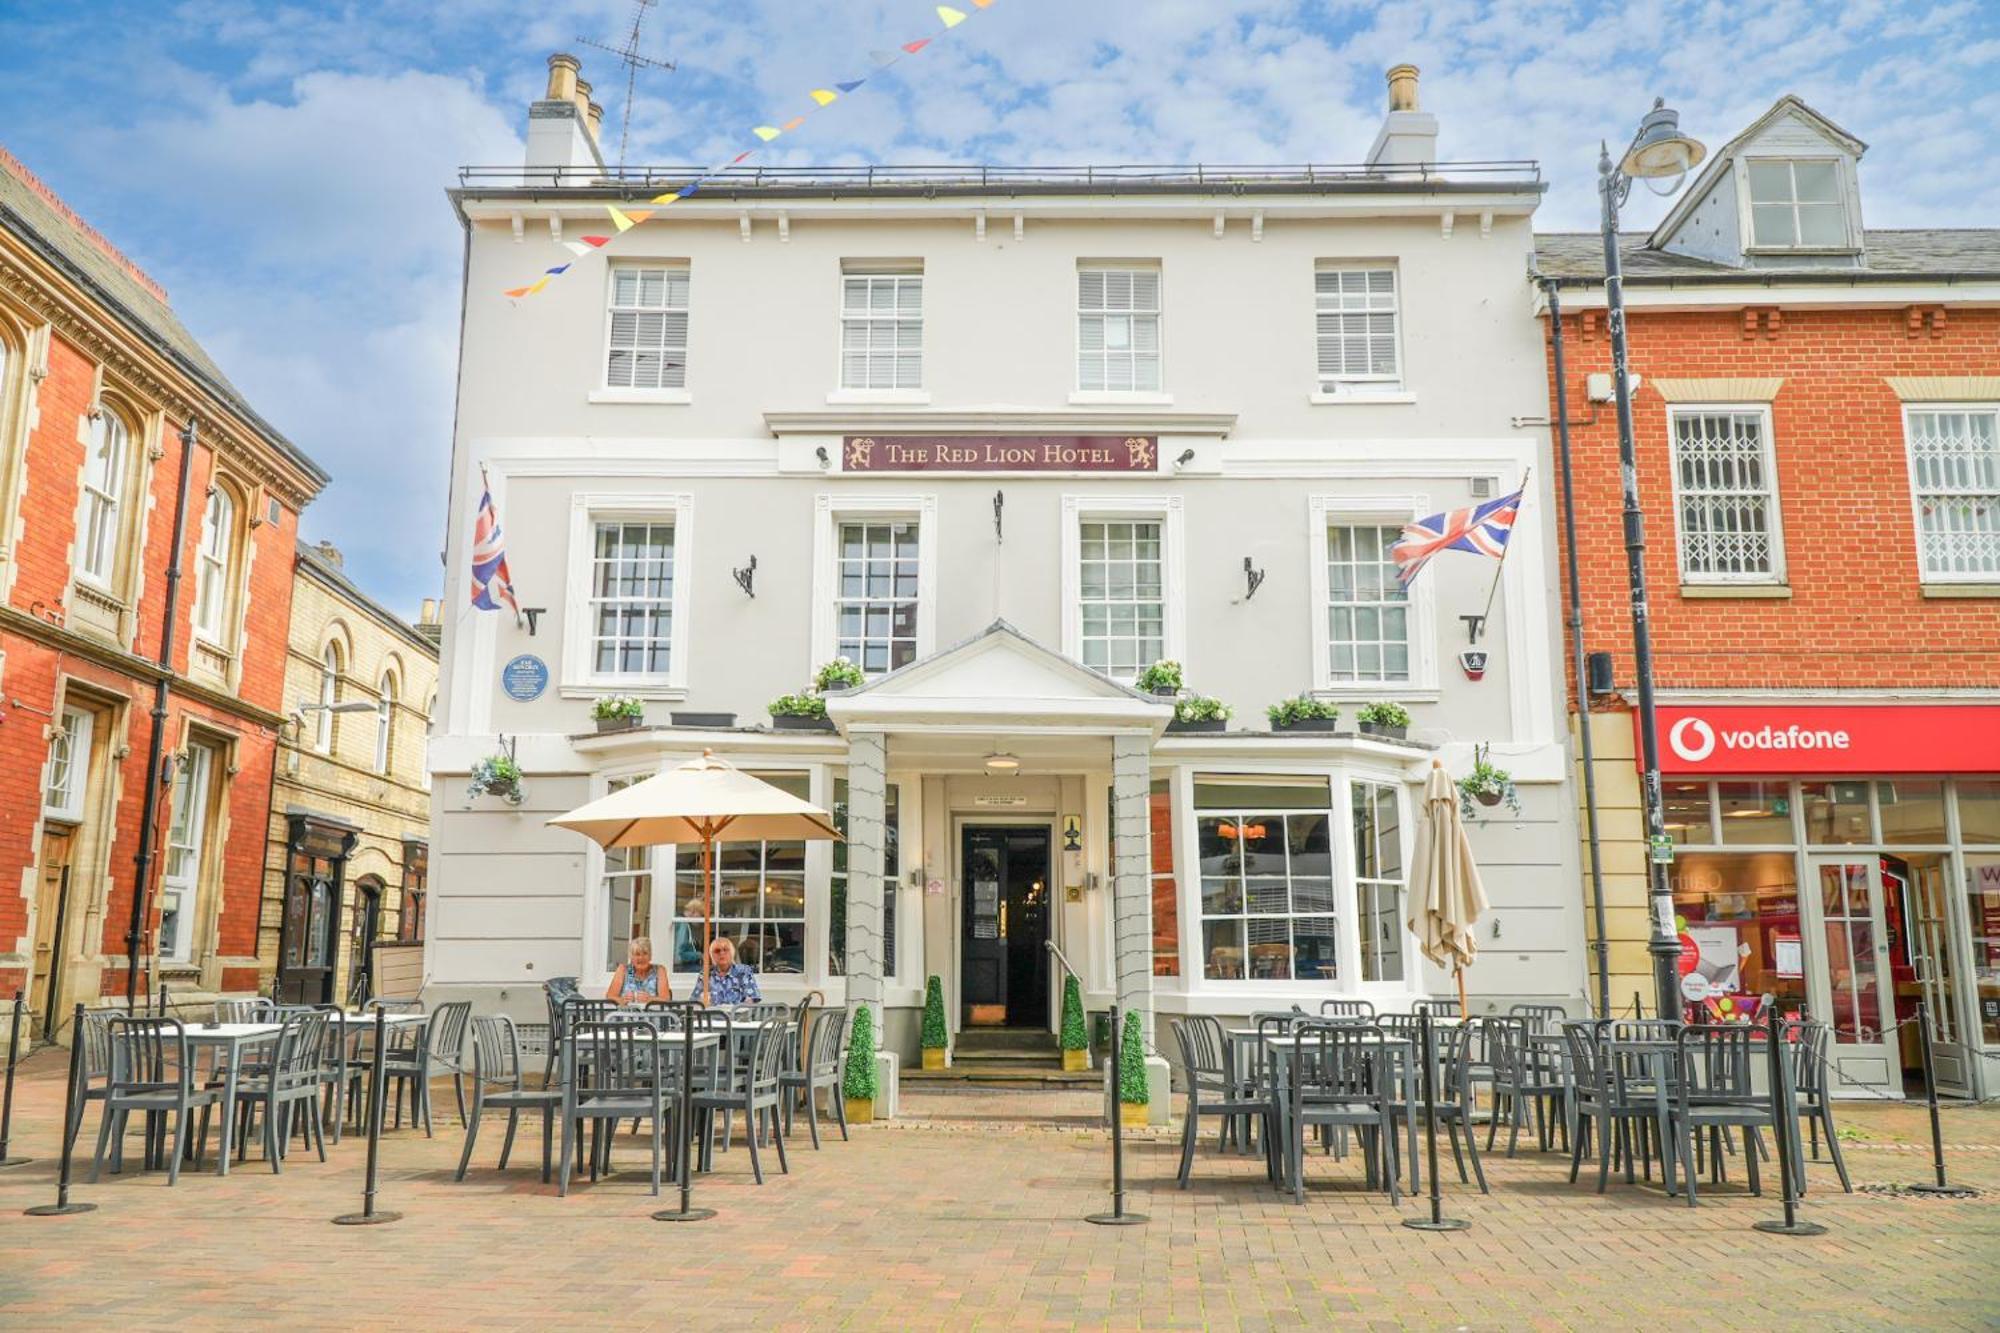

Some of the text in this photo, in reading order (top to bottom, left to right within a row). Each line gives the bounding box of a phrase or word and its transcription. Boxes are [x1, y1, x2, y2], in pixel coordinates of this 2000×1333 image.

[885, 444, 1115, 464] THE RED LION HOTEL
[1721, 725, 1850, 749] vodafone
